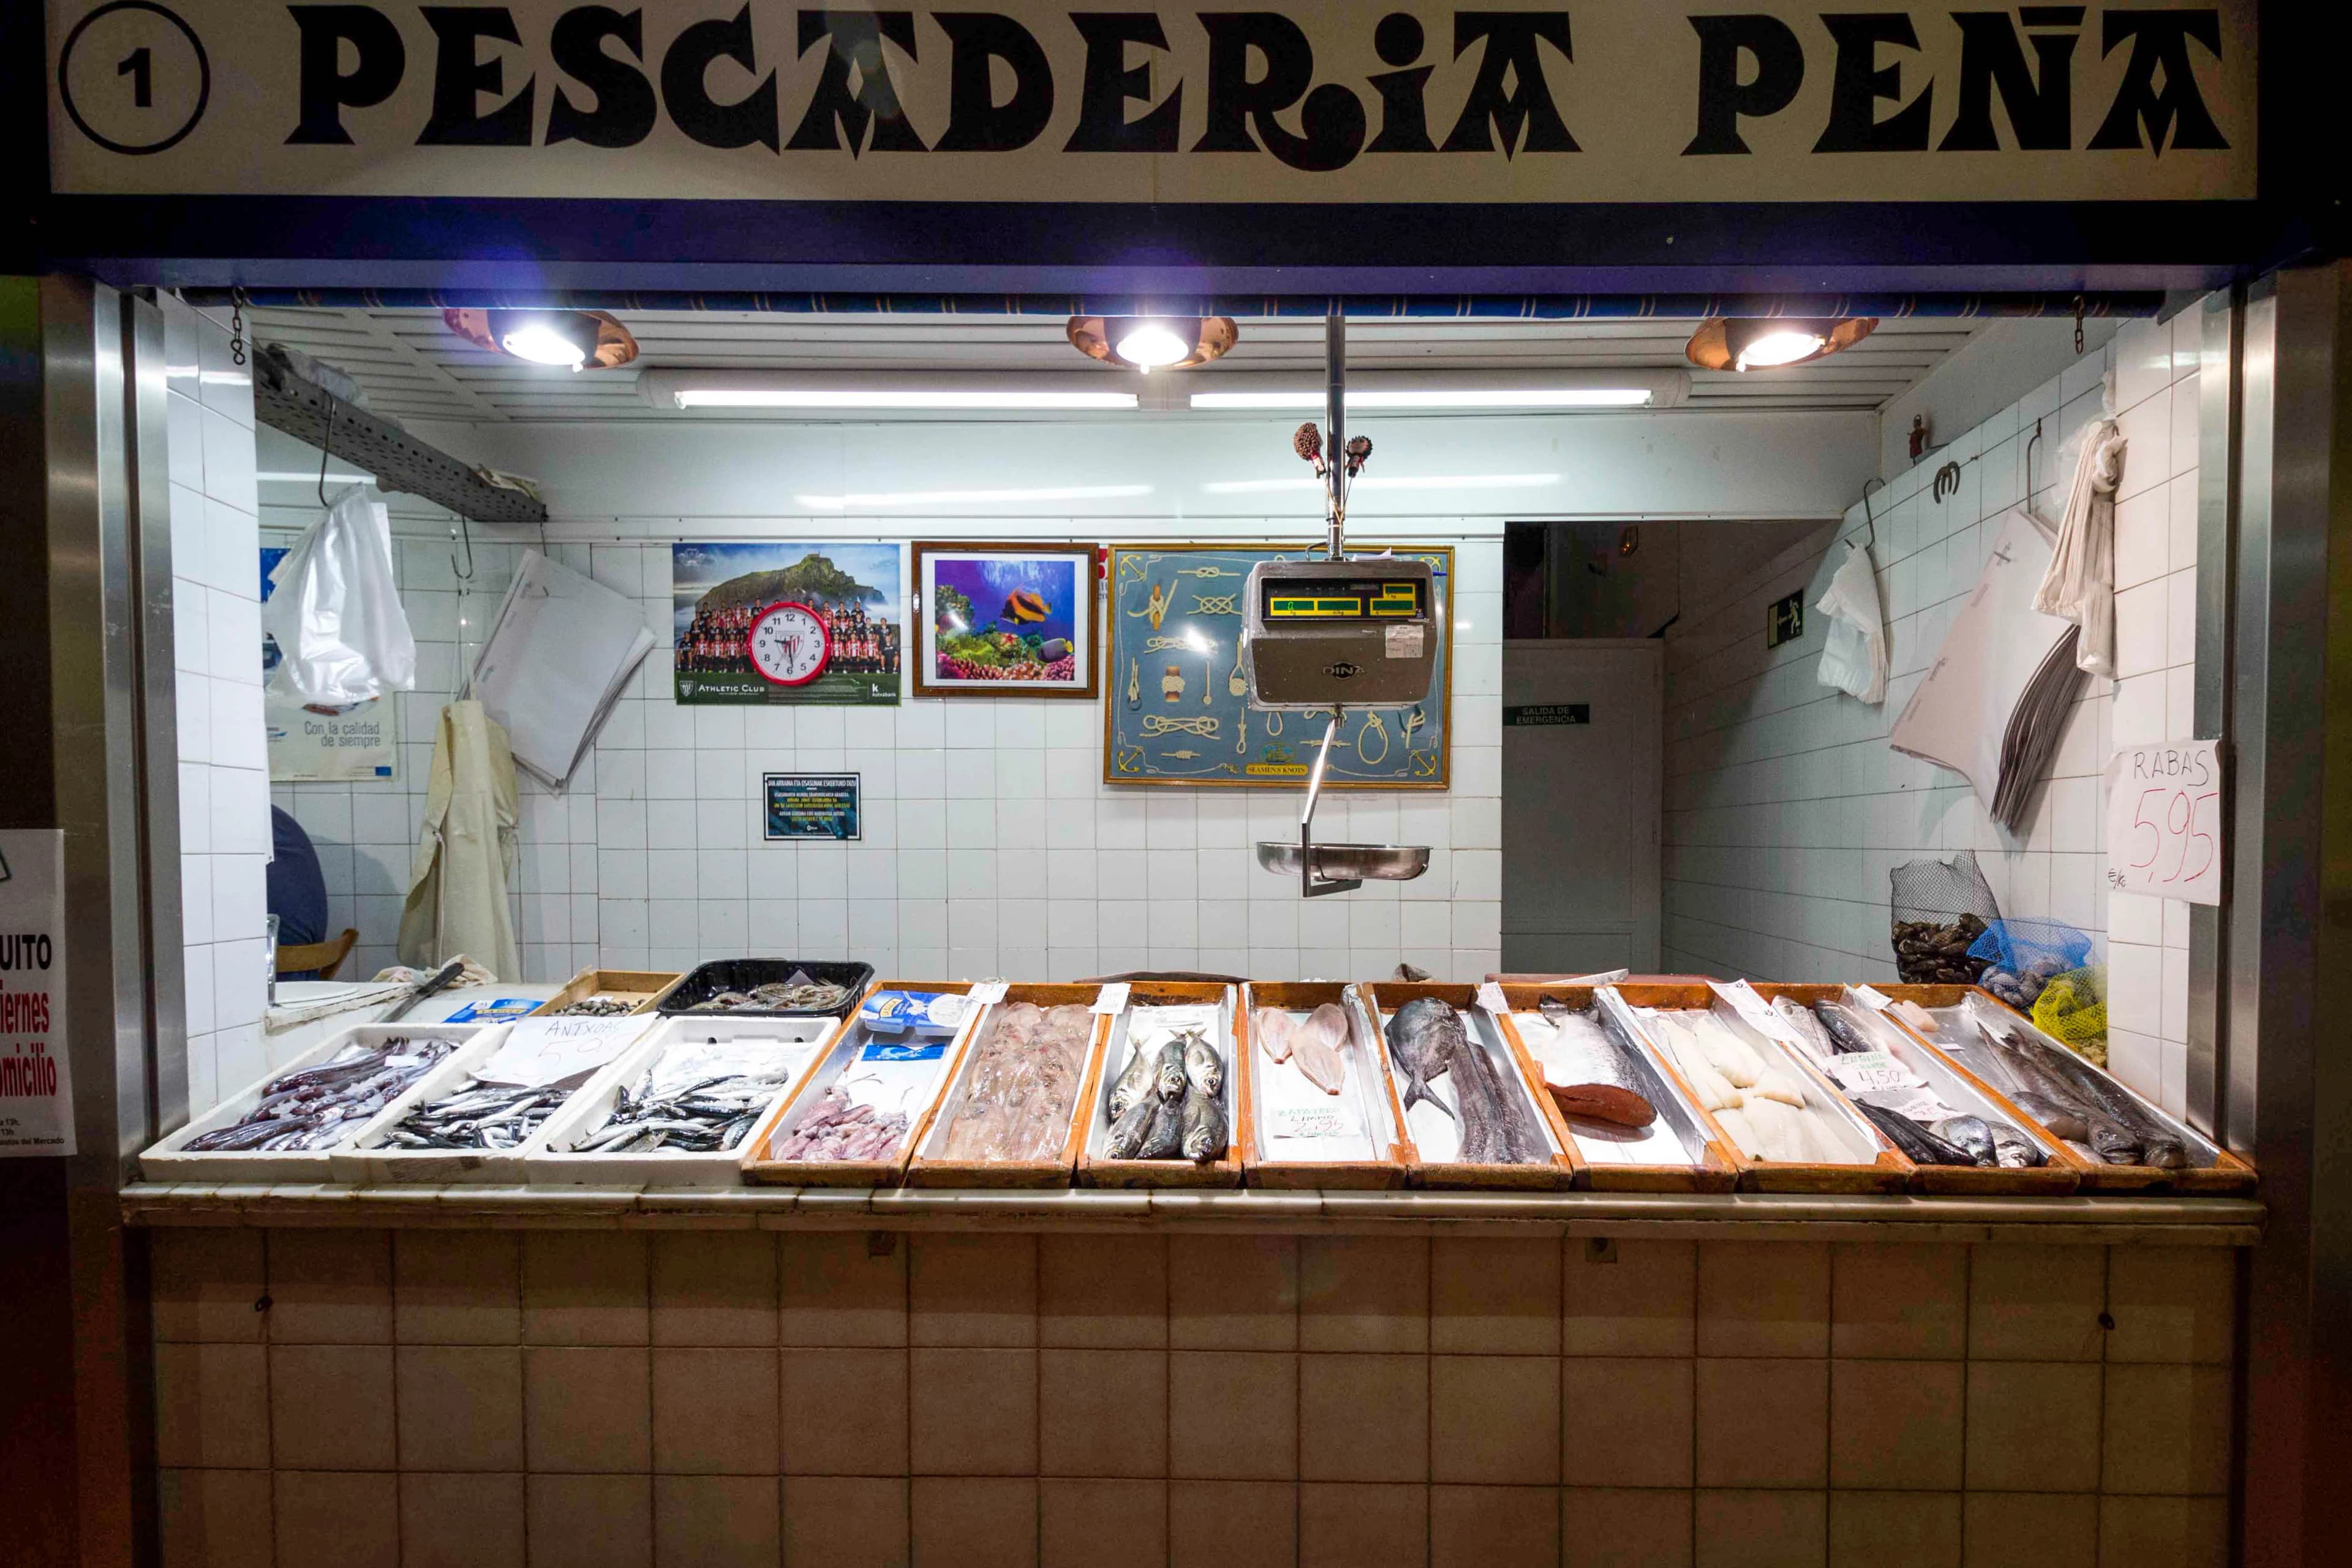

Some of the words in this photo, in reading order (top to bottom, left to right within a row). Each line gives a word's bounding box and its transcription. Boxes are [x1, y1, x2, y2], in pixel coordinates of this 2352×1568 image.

[117, 47, 153, 107] 1
[1679, 7, 2232, 159] PEÑA
[1523, 707, 1555, 715] SALIDA
[1517, 715, 1576, 725] EMERGENCIA
[305, 721, 324, 735] Con
[329, 722, 338, 734] la
[342, 722, 380, 735] calidad
[321, 736, 334, 747] de
[339, 736, 381, 748] siempre
[2134, 750, 2209, 786] RABAS
[33, 1137, 65, 1145] Mercado
